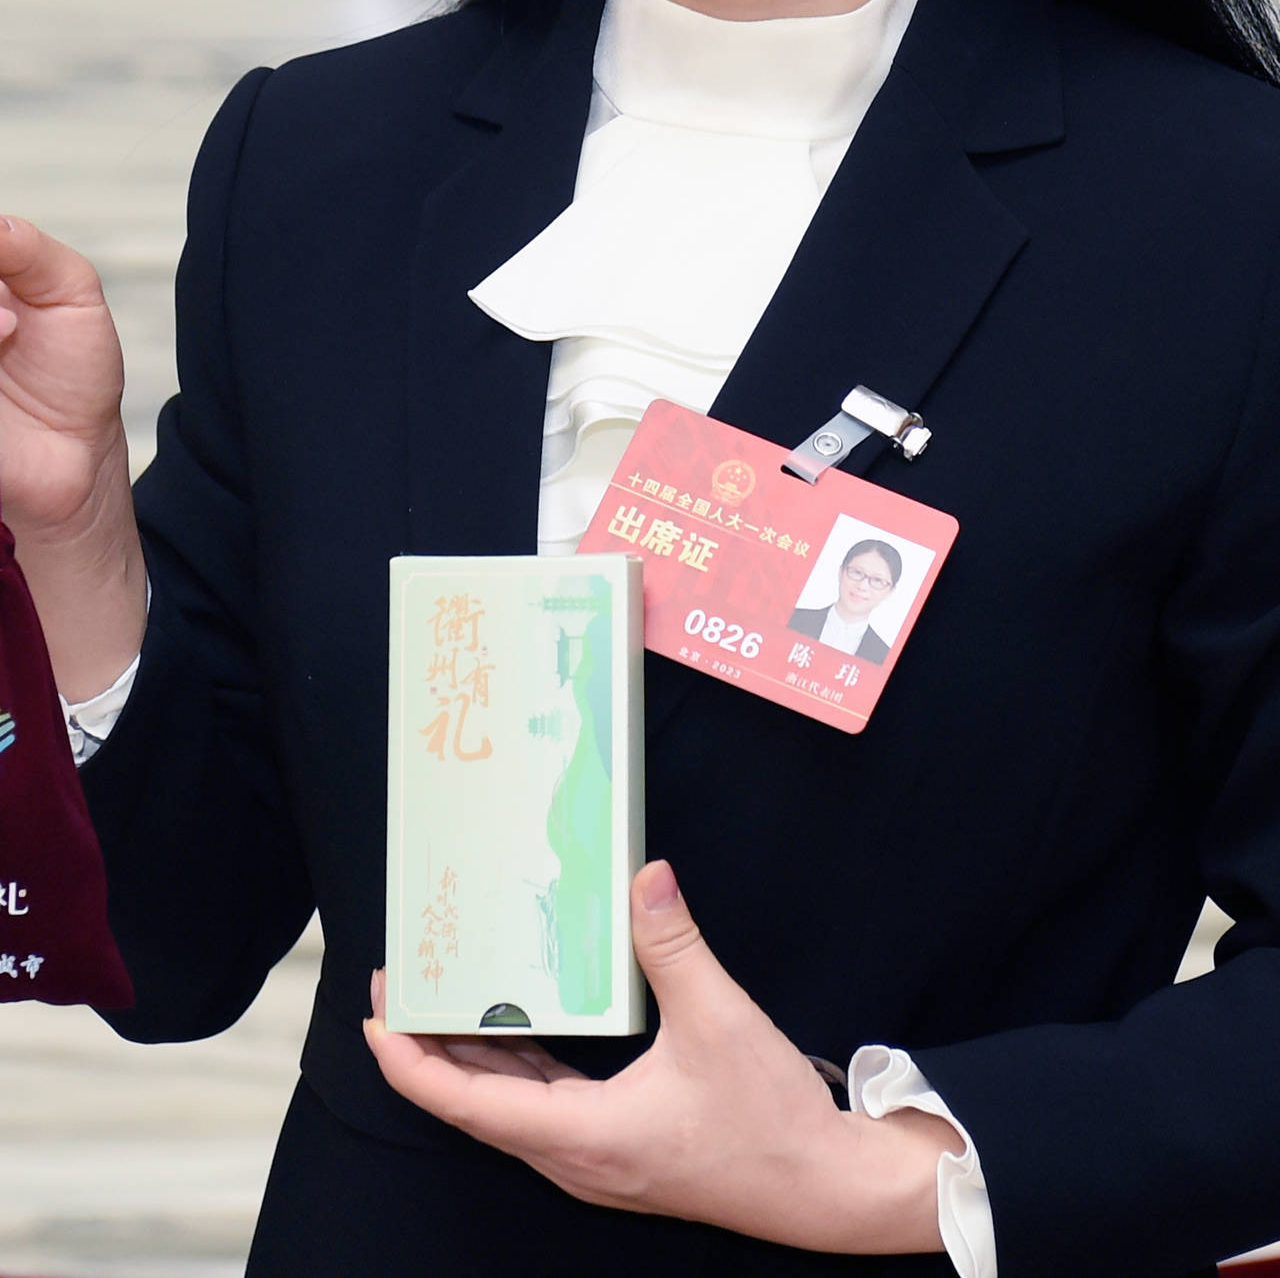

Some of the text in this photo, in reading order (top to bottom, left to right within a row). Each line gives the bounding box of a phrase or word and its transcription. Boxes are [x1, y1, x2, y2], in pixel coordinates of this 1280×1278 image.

[607, 504, 720, 573] 出席证
[627, 472, 811, 559] 十四届全国人大一次会议
[684, 608, 764, 660] 0826
[787, 641, 815, 669] 陈
